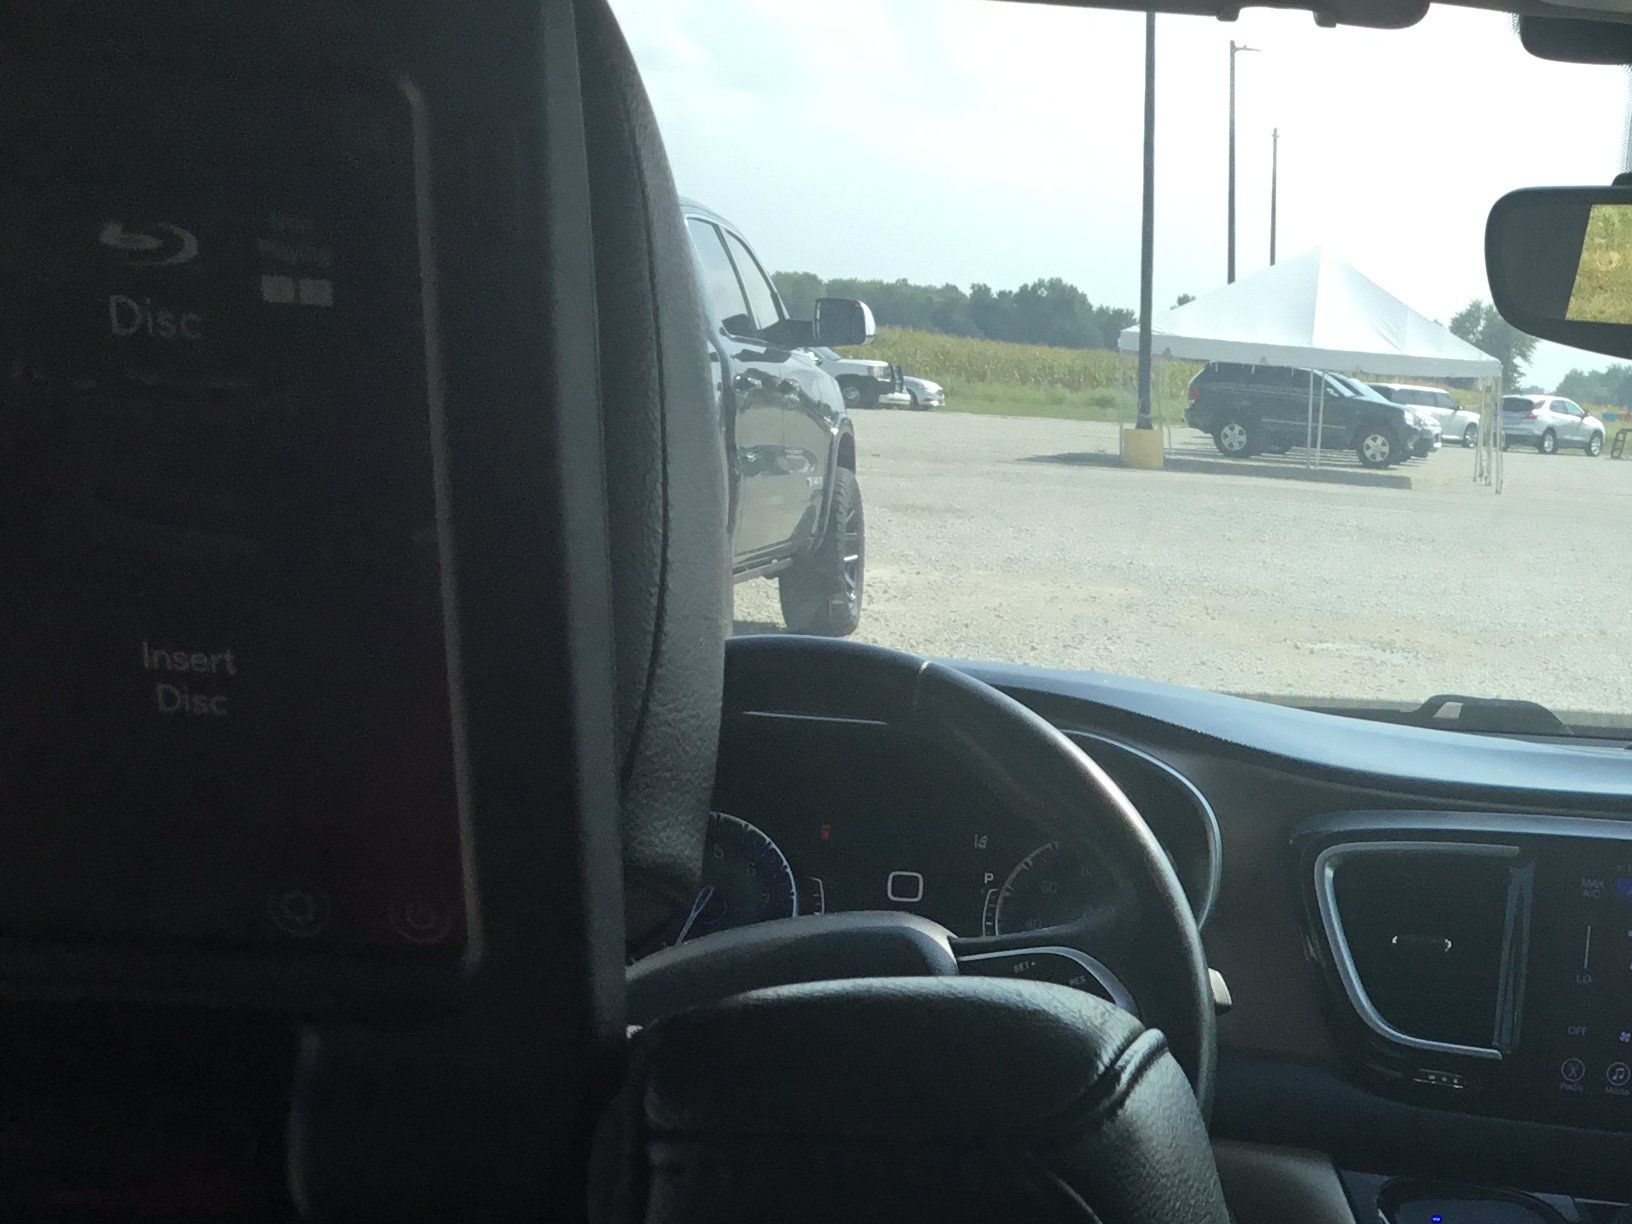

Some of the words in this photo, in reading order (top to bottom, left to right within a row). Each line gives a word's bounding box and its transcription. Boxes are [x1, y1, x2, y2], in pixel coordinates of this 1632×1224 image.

[109, 294, 203, 340] Disc
[142, 640, 238, 676] Insert
[157, 682, 229, 716] Disc
[984, 872, 994, 884] P
[1568, 1025, 1588, 1036] OFF
